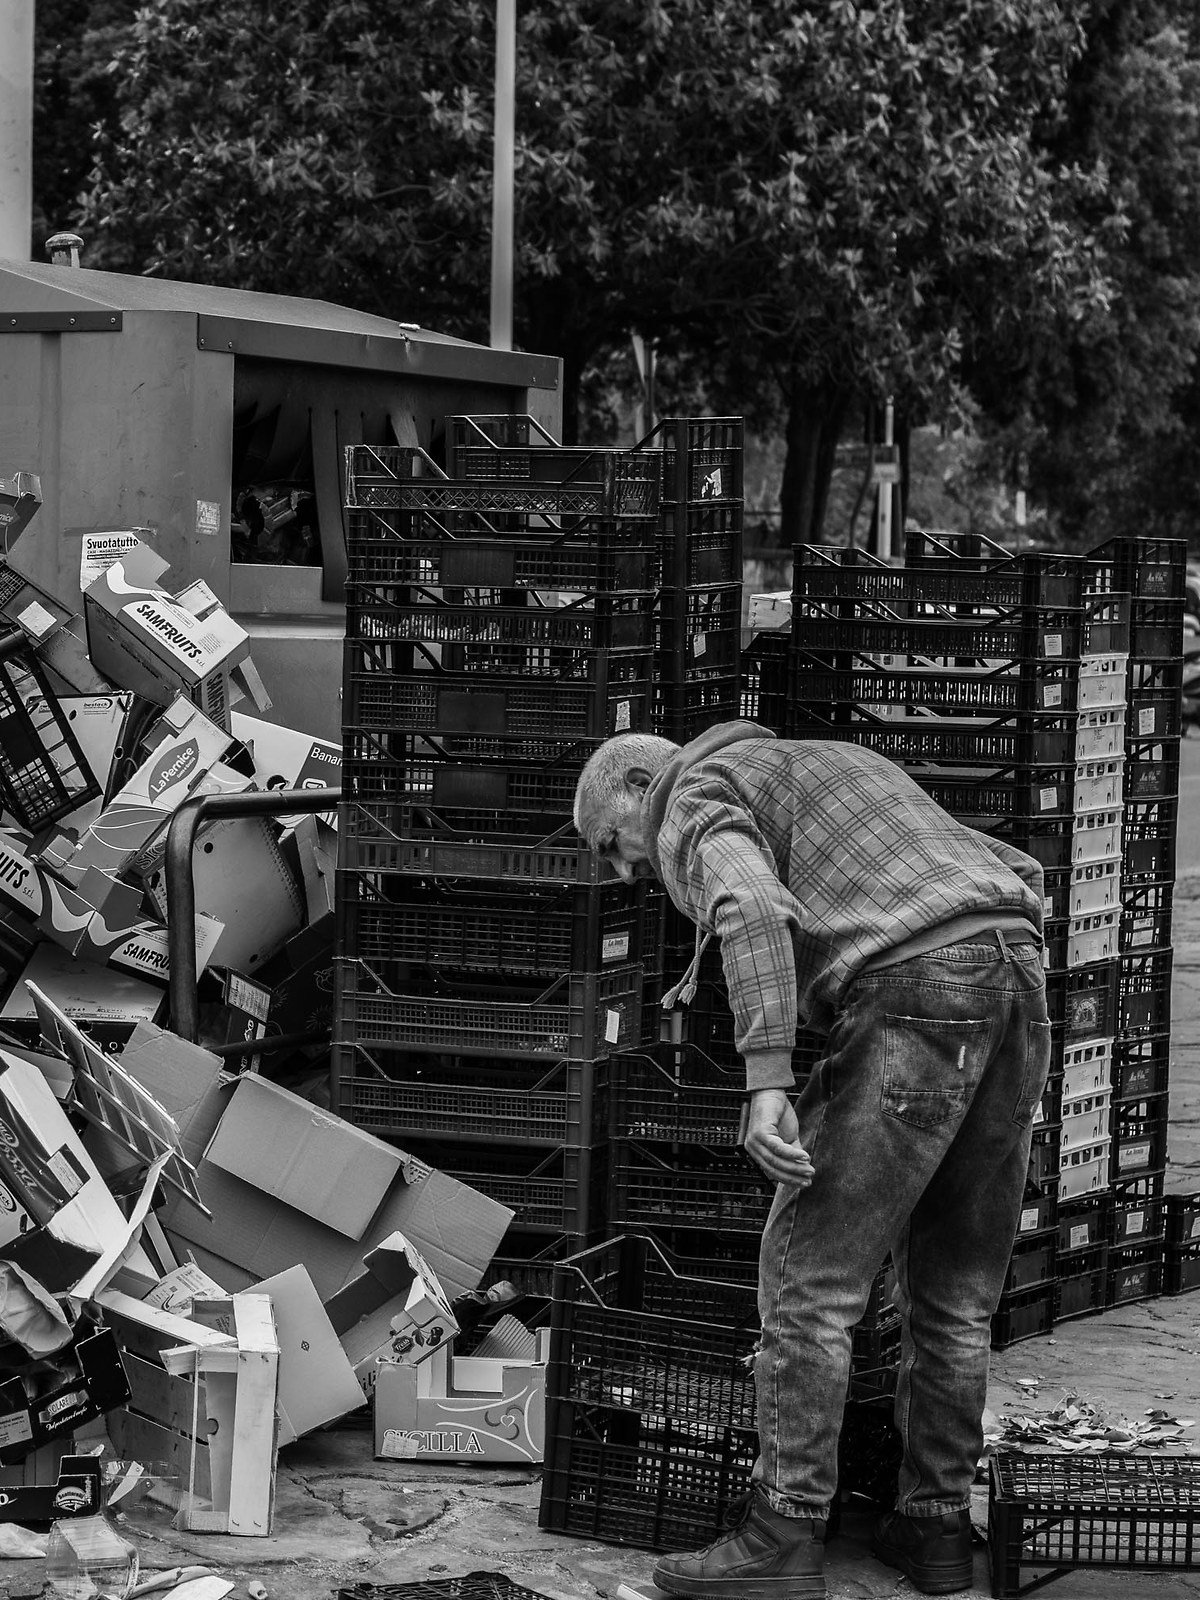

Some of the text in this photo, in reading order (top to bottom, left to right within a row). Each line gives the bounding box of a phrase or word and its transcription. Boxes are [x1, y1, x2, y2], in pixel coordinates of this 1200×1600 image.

[86, 536, 140, 550] Svuotatutto
[137, 603, 203, 660] SAMFRUITS
[311, 747, 343, 767] Banan
[122, 942, 170, 970] SAMFRU
[383, 1428, 485, 1455] CILIA
